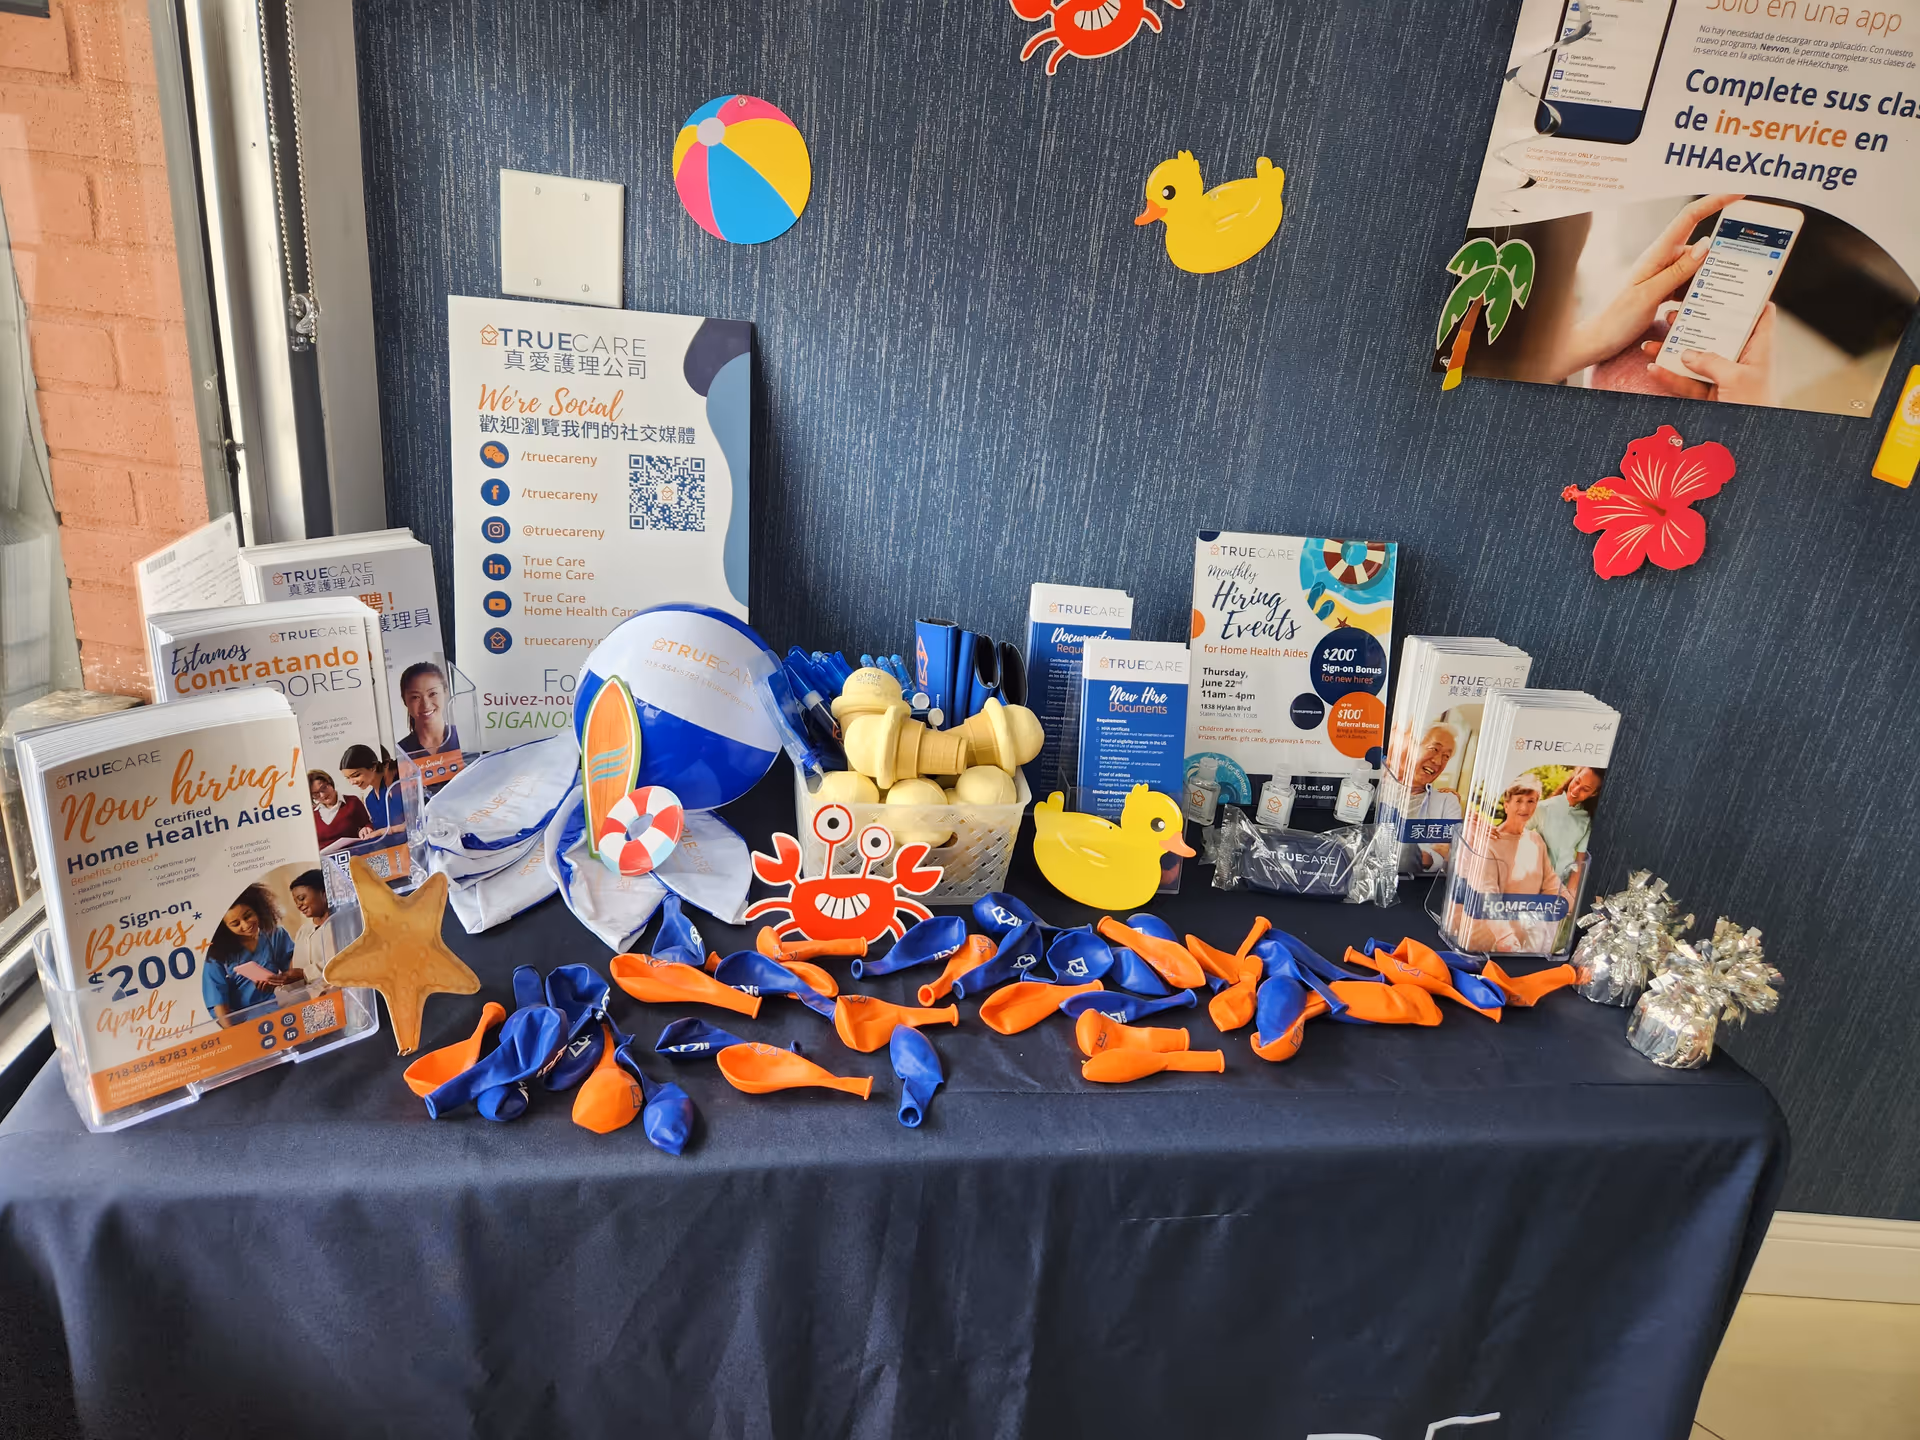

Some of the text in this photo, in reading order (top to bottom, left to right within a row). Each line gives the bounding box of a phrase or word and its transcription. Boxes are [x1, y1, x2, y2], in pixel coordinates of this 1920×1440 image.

[1767, 0, 1797, 19] en
[1804, 3, 1850, 25] una
[1855, 9, 1902, 39] app
[1699, 25, 1710, 33] No
[1712, 27, 1726, 36] hay
[1727, 29, 1764, 40] necesidad
[1776, 32, 1812, 46] descargar
[1813, 39, 1828, 47] otra
[1869, 45, 1884, 54] Con
[1885, 48, 1914, 58] nuestro
[1693, 46, 1728, 57] in-service
[1740, 51, 1747, 59] la
[1785, 57, 1795, 65] de
[1696, 36, 1719, 45] nuevo
[1720, 39, 1758, 50] programa,
[1800, 49, 1830, 59] permite
[1831, 52, 1868, 63] completar
[1869, 57, 1882, 65] sus
[1883, 58, 1905, 68] clases
[1906, 61, 1916, 69] de
[1685, 68, 1818, 106] Complete
[1823, 89, 1872, 113] sus
[1674, 105, 1888, 152] de in-service en
[1664, 142, 1858, 191] HHAeXchange
[499, 327, 647, 357] TRUECARE
[503, 349, 648, 380] 真愛護理公司
[478, 383, 624, 422] We're Social
[479, 414, 696, 445] 歡迎瀏覽我們的社交媒體
[521, 451, 598, 467] /truecareny
[521, 488, 598, 504] /truecareny
[522, 525, 605, 540] @truecareny
[523, 555, 585, 567] True Care
[1221, 545, 1295, 560] TRUECARE
[282, 561, 373, 583] TRUECARE
[523, 569, 562, 580] Home
[565, 569, 595, 580] Care
[1207, 561, 1259, 585] Monthly
[524, 592, 586, 604] True Care
[1212, 580, 1287, 622] Hiring
[524, 605, 608, 617] Home Health
[1057, 603, 1126, 618] TRUECARE
[279, 625, 359, 642] TRUECARE
[1221, 609, 1301, 642] Events
[171, 643, 251, 676] Estamos
[1204, 644, 1308, 659] for Home Health Aides
[174, 646, 359, 694] Contratando
[1109, 658, 1183, 673] TRUECARE
[1203, 667, 1249, 679] Thursday,
[1322, 663, 1382, 675] Sign-on Bonus
[1201, 679, 1223, 688] June
[1321, 674, 1374, 685] for new hires
[1449, 675, 1521, 688] TRUECARE
[1109, 685, 1168, 705] New Hire
[1202, 691, 1255, 702] 11am 4pm
[1109, 701, 1167, 714] Documents
[1216, 704, 1236, 712] Hylan
[1525, 739, 1605, 755] TRUECARE
[66, 750, 162, 786] TRUECARE
[60, 747, 300, 844] Now hiring!
[154, 806, 212, 828] Certified
[66, 803, 302, 875] Home Health Aides
[153, 856, 197, 871] Overtime pay
[234, 857, 286, 874] benefits program
[71, 867, 112, 887] Benefits
[103, 877, 122, 886] Hours
[156, 866, 196, 881] Vacation pay
[157, 879, 175, 887] never
[103, 889, 115, 898] pay
[81, 894, 132, 914] Competitive pay
[119, 900, 192, 930] Sign-on
[107, 1037, 221, 1082] 718-854-8783 691
